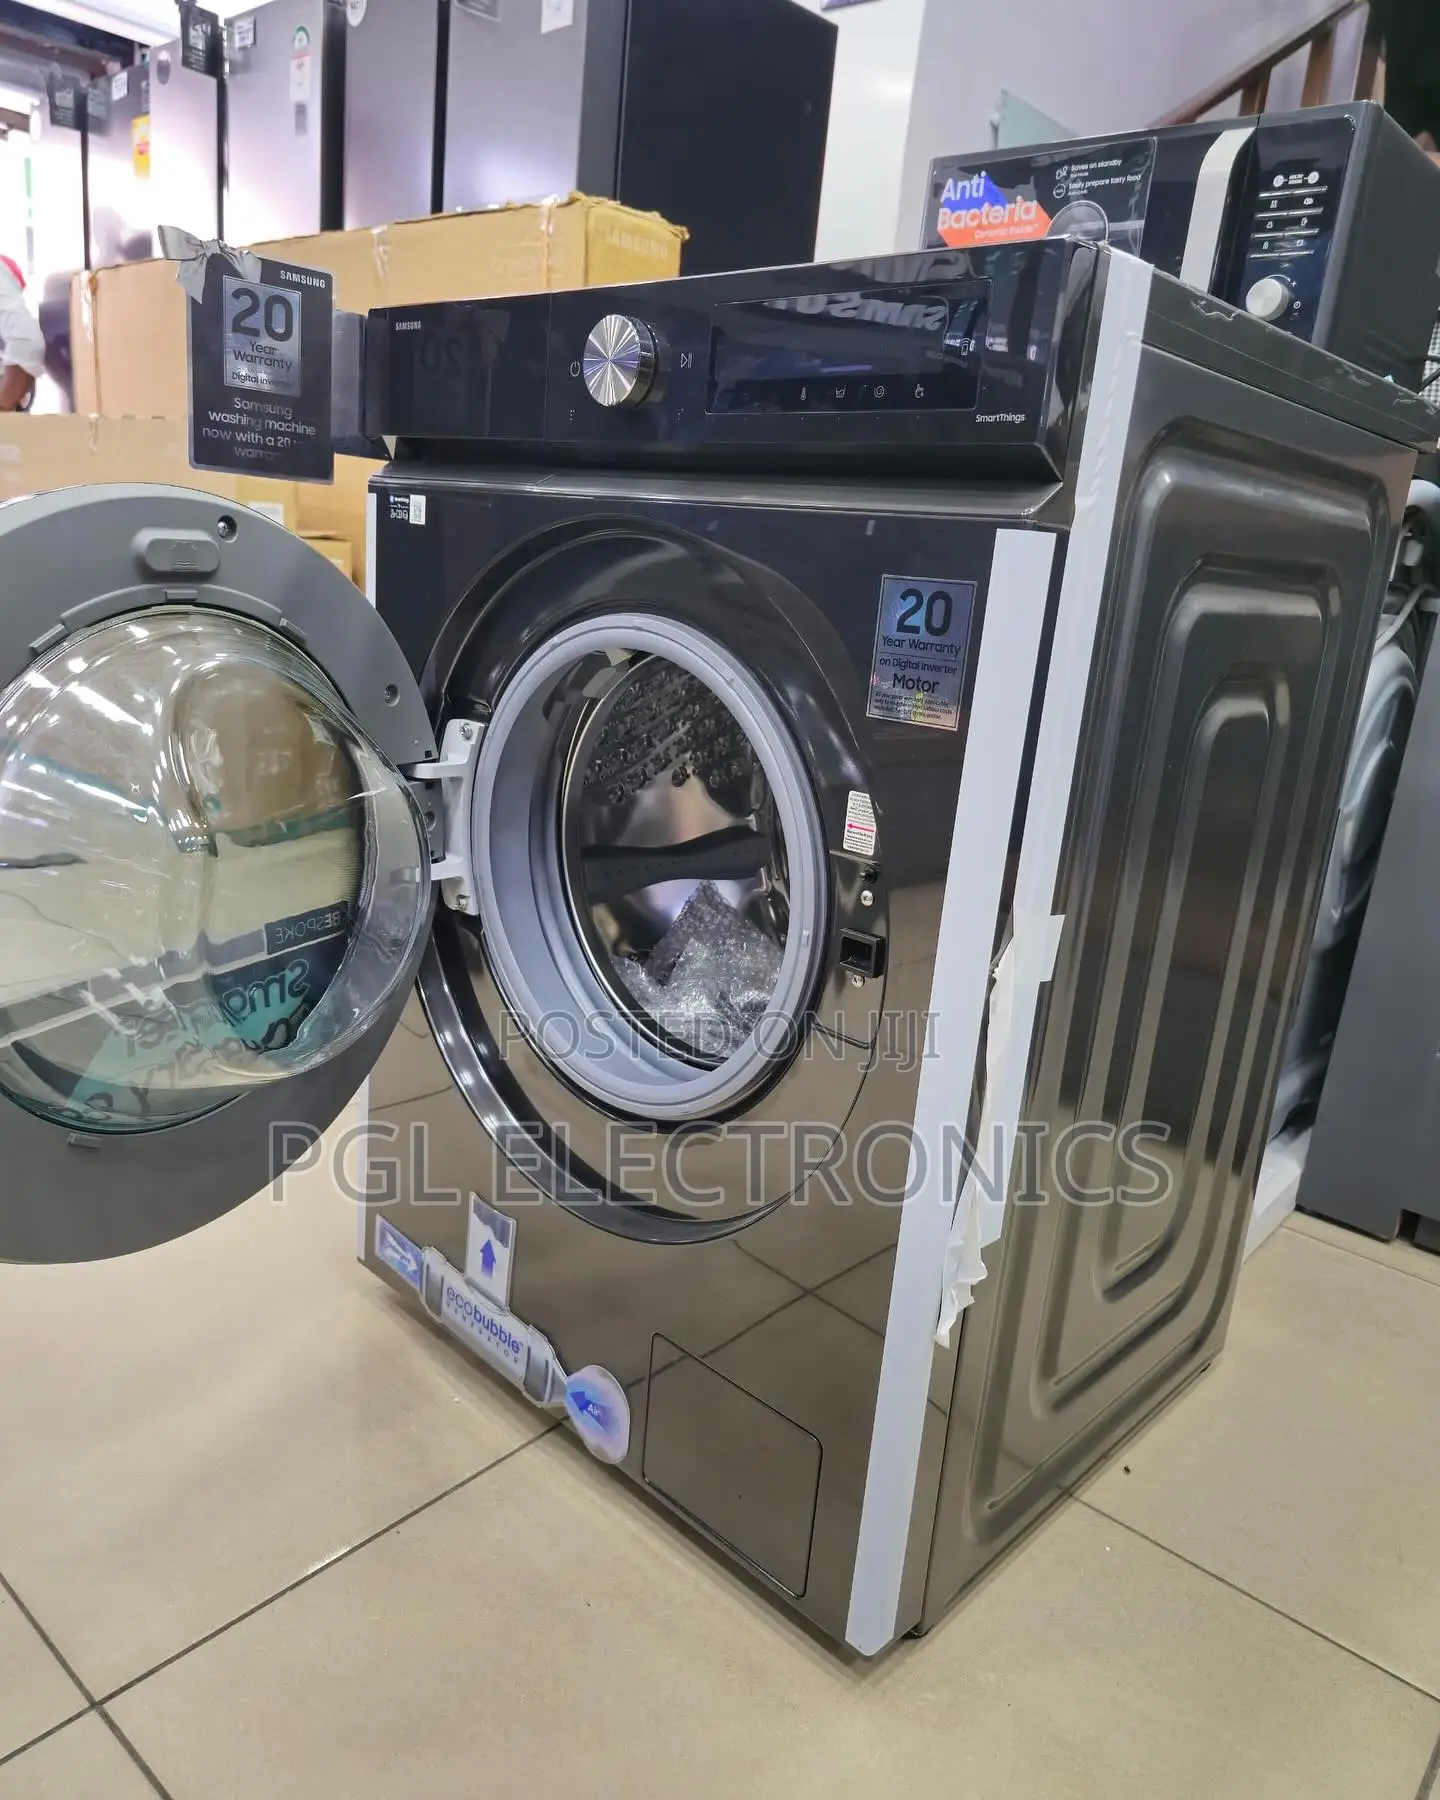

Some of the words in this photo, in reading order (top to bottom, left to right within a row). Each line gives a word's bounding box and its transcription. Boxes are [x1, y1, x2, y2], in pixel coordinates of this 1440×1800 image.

[1098, 159, 1122, 168] standby
[940, 170, 986, 203] Anti
[1069, 181, 1084, 190] Easily
[1085, 178, 1110, 188] prepare
[1111, 176, 1126, 184] tasty
[1127, 174, 1141, 182] food
[938, 196, 1037, 229] Bacteria
[280, 270, 326, 289] SAMSUNG
[231, 288, 294, 342] 20
[395, 321, 422, 331] SAMSUNG
[249, 341, 278, 356] Year
[233, 349, 292, 372] Warranty
[232, 372, 259, 383] Digital
[234, 397, 293, 420] Samsung
[975, 412, 1026, 424] SmartThings
[208, 411, 262, 431] washing
[265, 419, 317, 436] machine
[202, 427, 232, 441] now
[235, 431, 263, 445] with
[265, 436, 274, 446] a
[896, 588, 953, 637] 20
[881, 635, 907, 648] Year
[908, 638, 961, 658] Warranty
[879, 657, 891, 666] on
[892, 657, 919, 671] Digital
[892, 673, 940, 694] Motor
[587, 1403, 602, 1416] Air
